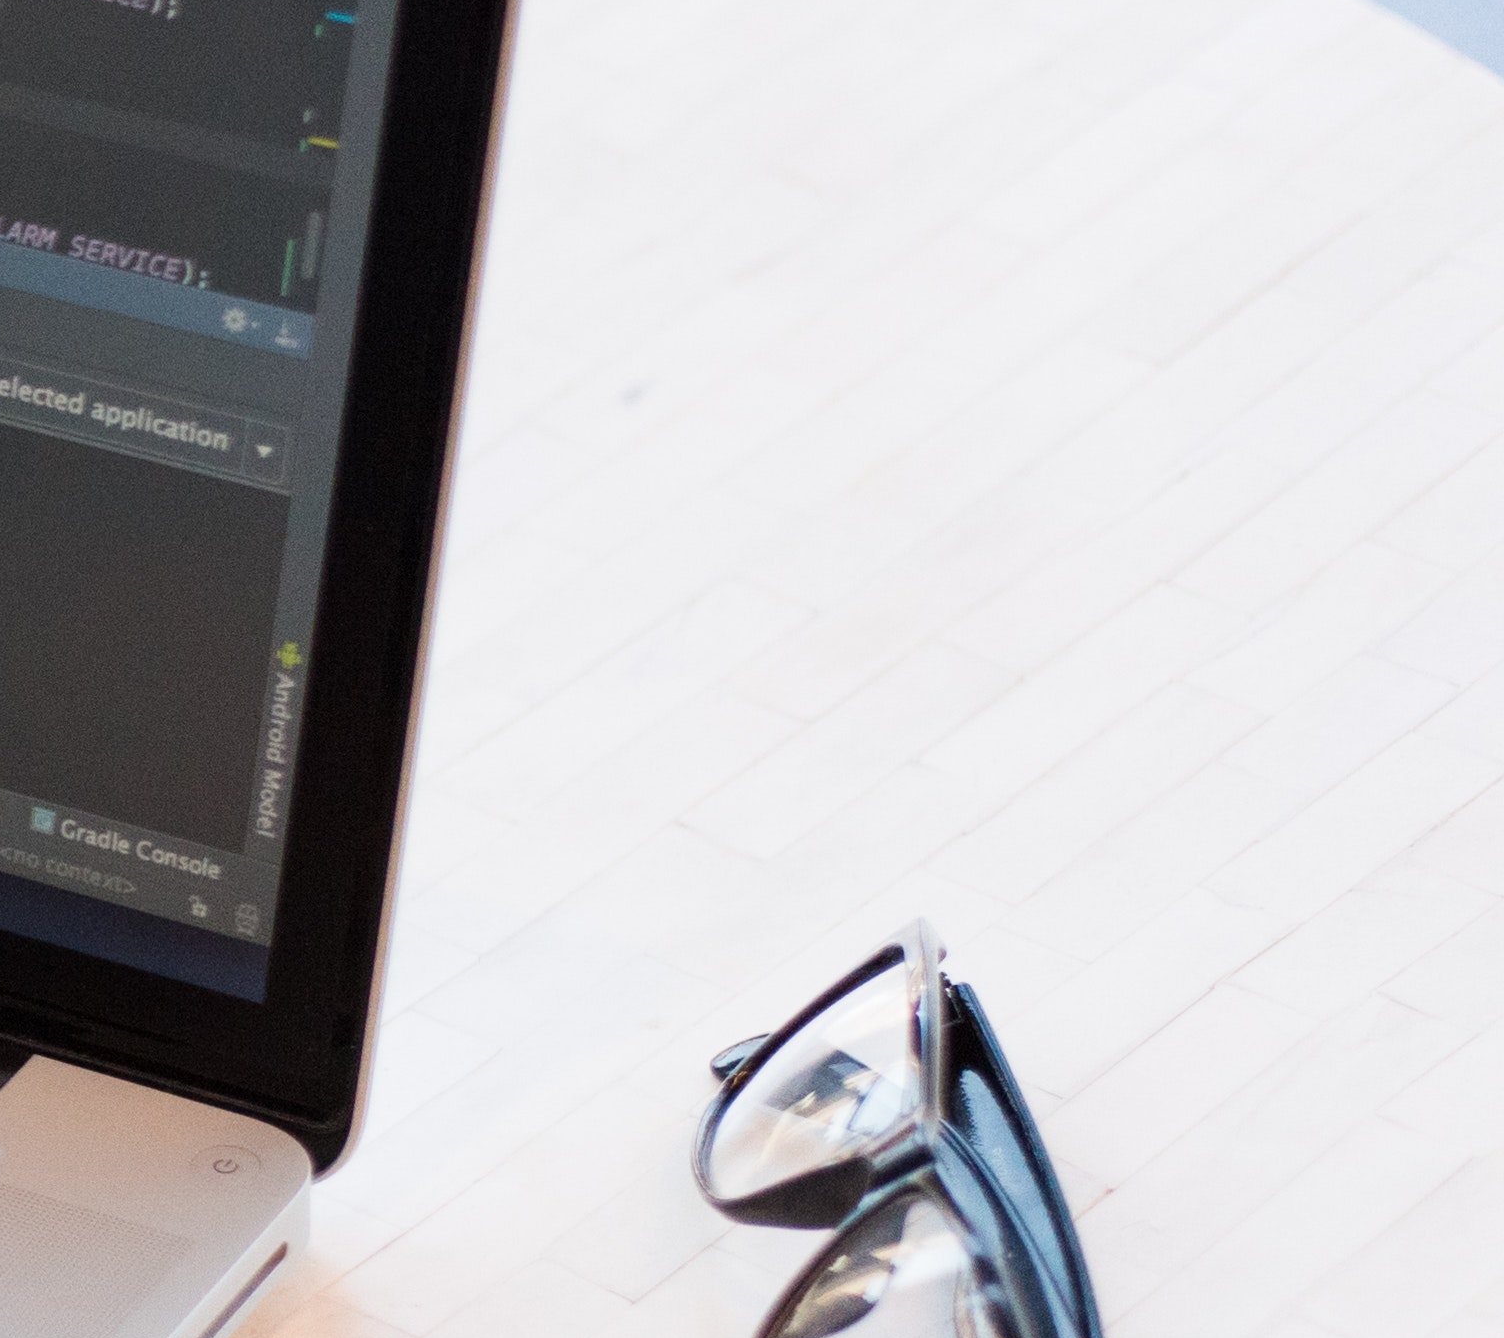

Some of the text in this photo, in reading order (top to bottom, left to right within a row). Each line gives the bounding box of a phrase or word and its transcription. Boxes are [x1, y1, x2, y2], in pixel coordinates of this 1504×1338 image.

[90, 398, 233, 452] application
[254, 673, 296, 839] Android Model
[58, 816, 223, 883] Gradle Console
